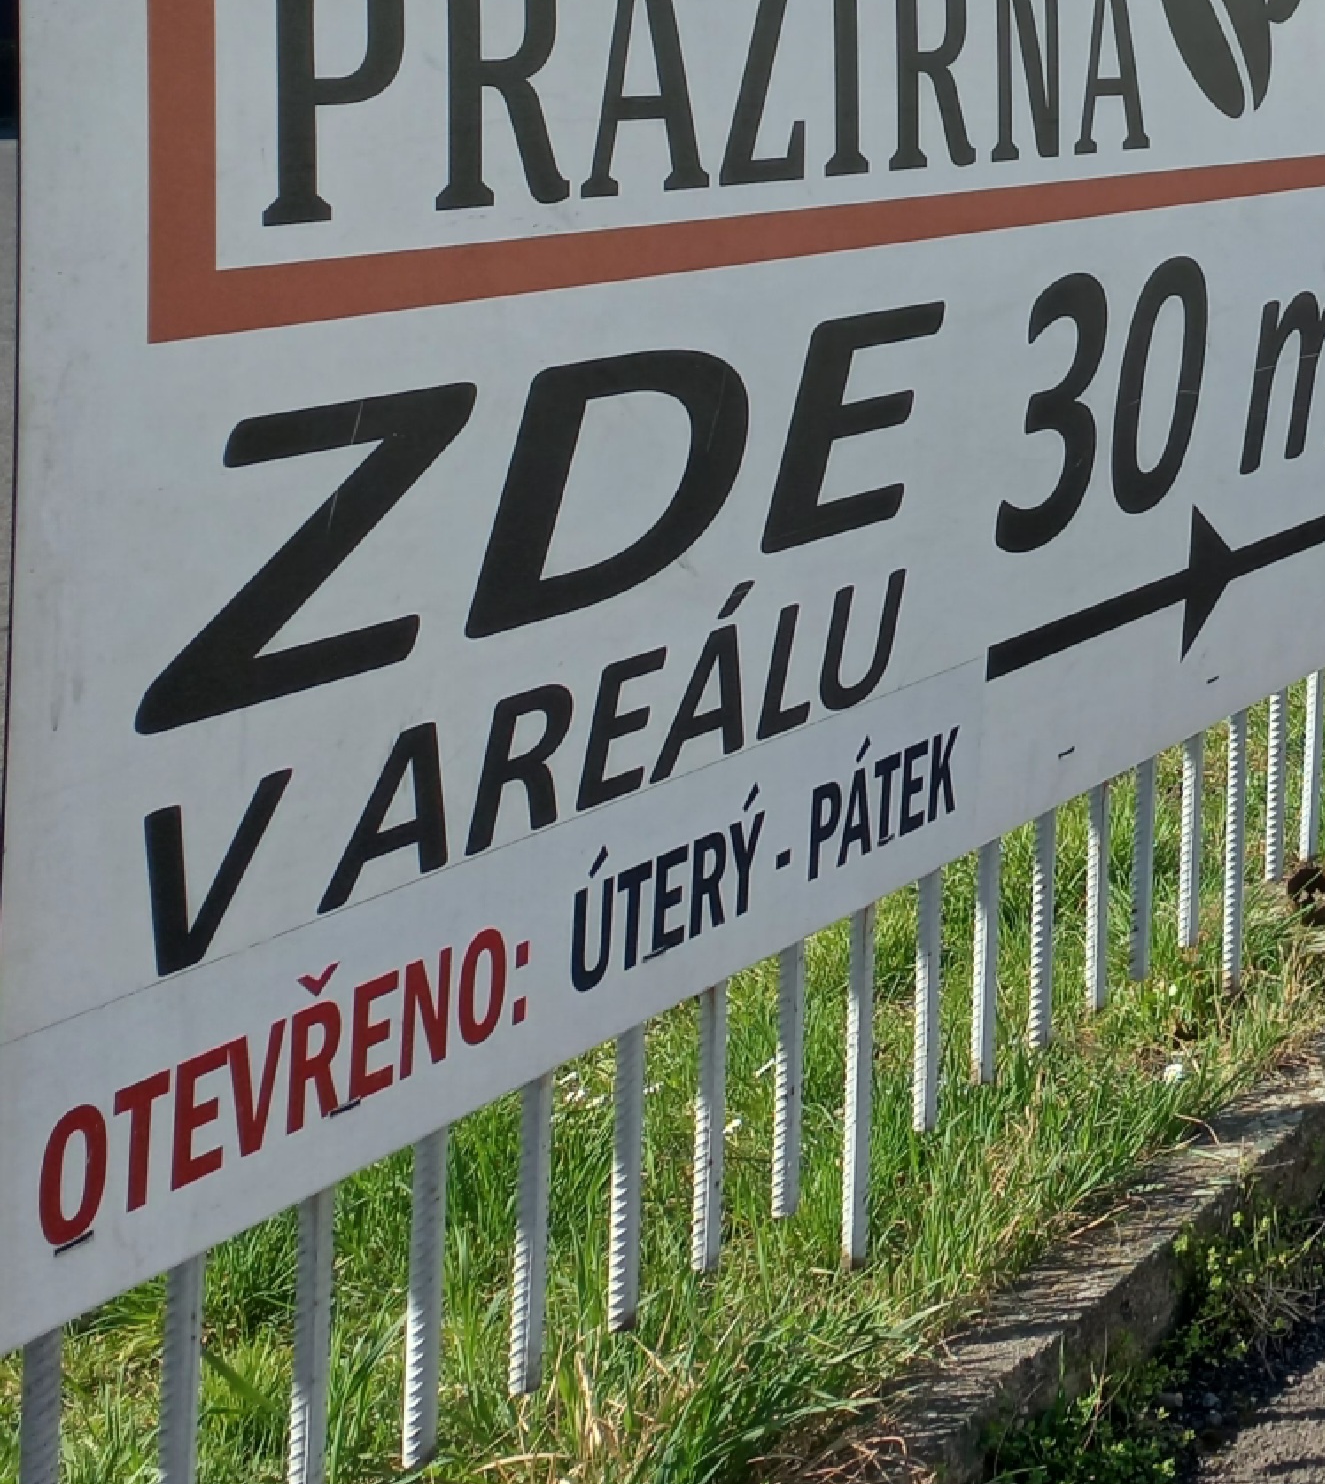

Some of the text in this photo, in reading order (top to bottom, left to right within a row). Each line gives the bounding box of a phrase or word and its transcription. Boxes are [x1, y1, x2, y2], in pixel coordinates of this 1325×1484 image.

[134, 301, 944, 734] ZDE
[995, 255, 1208, 553] 30
[38, 929, 531, 1249] OTEVŘENO:
[570, 784, 764, 995] ÚTERÝ
[807, 727, 960, 882] PÁTEK
[144, 569, 907, 976] V AREÁLU
